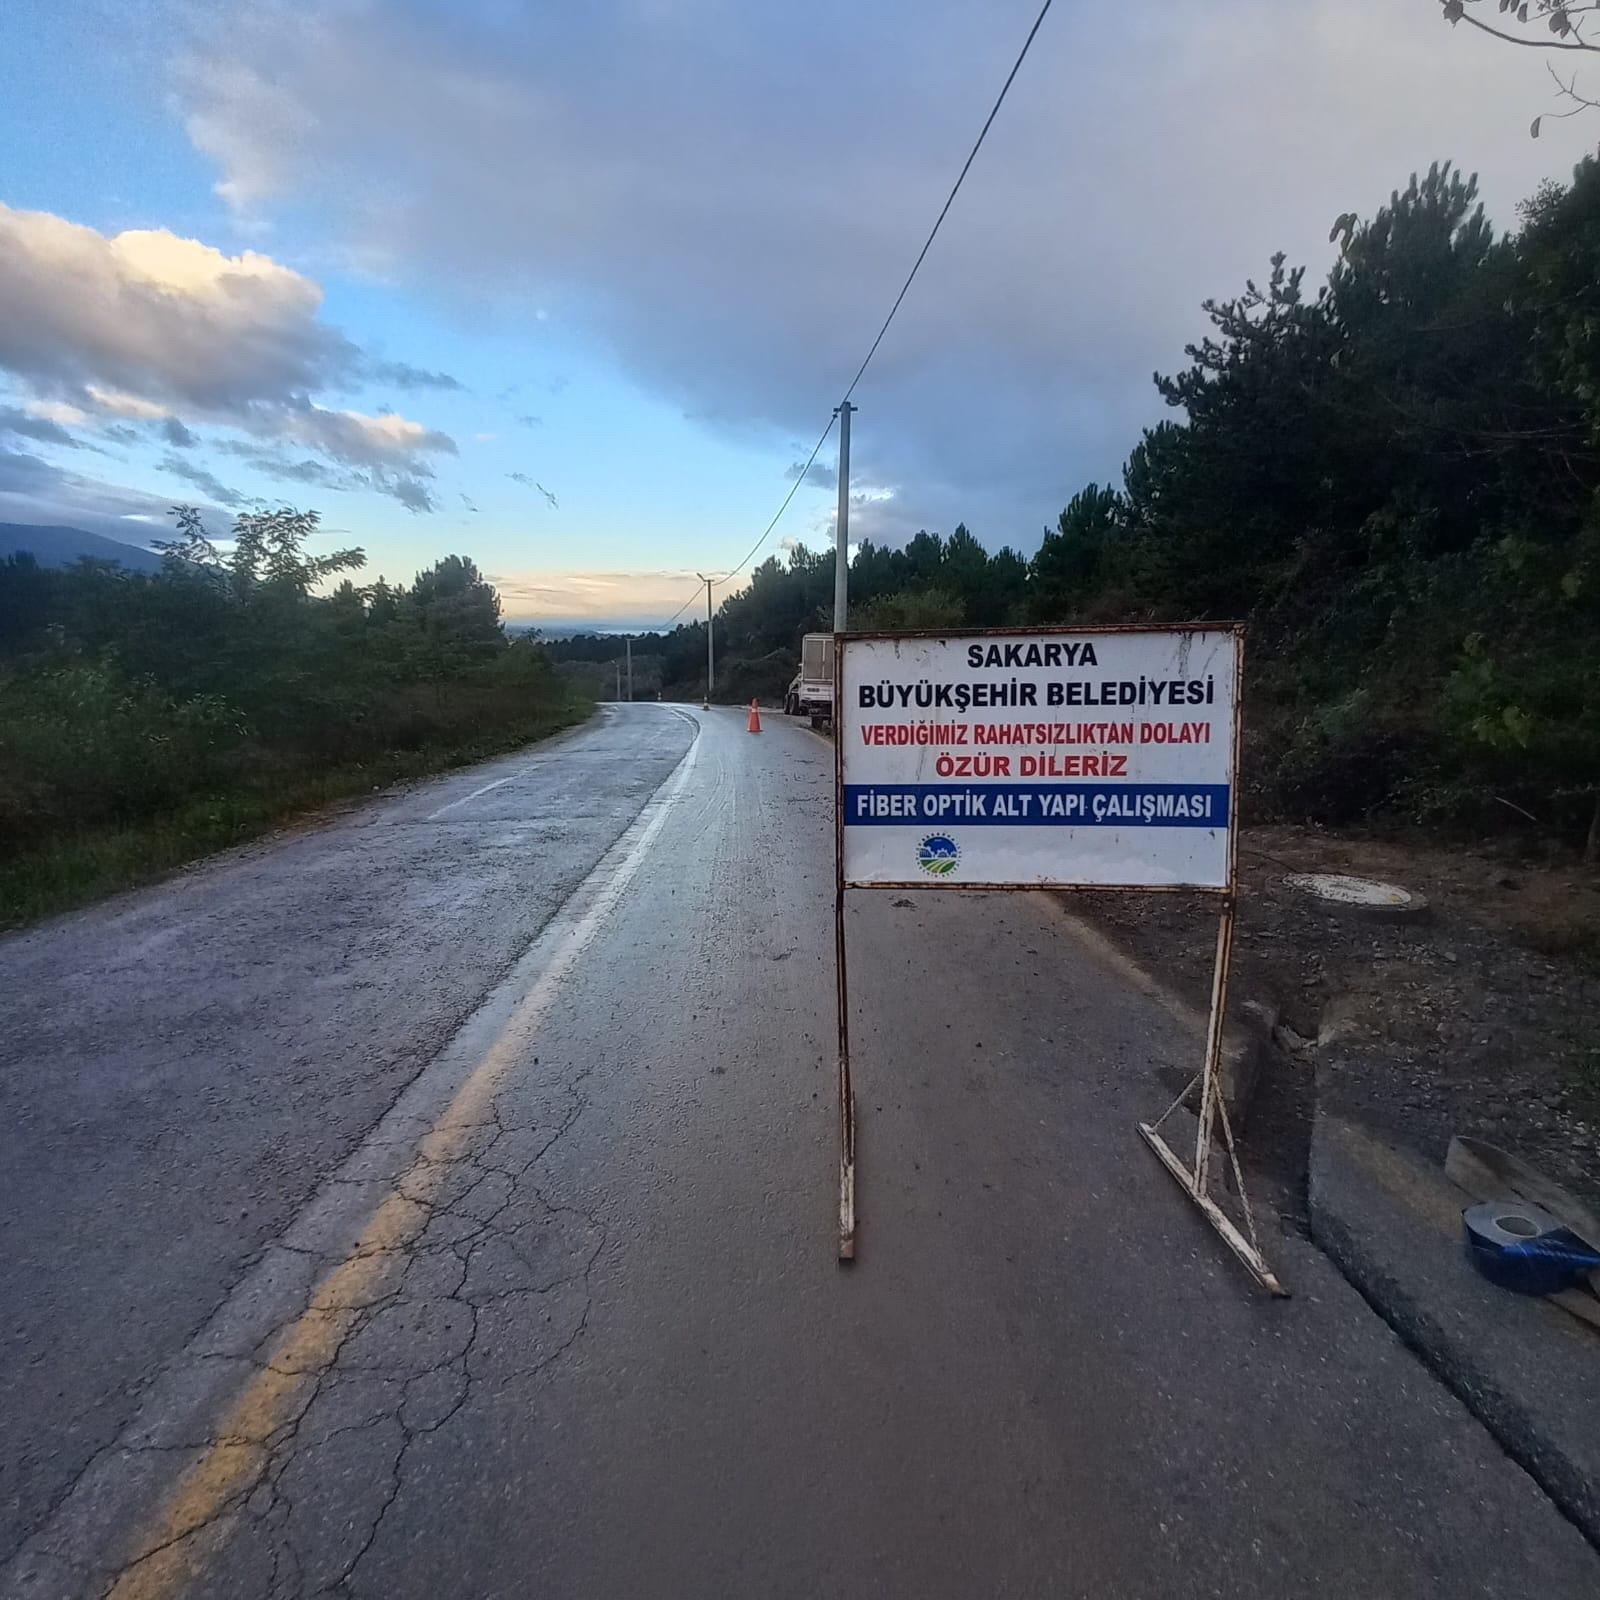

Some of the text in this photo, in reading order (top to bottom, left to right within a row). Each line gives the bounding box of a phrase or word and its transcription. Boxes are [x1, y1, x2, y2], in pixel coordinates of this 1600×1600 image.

[968, 643, 1097, 668] SAKARYA
[859, 675, 1214, 713] BÜYÜKŞEHİR BELEDİYESİ
[861, 720, 1210, 745] VERDİĞİMİZ RAHATSIZLIKTAN DOLAYI
[936, 751, 1127, 777] ÖZÜR DİLERİZ
[857, 789, 1211, 823] FİBER OPTİK ALT YAPI ÇALIŞMASI
